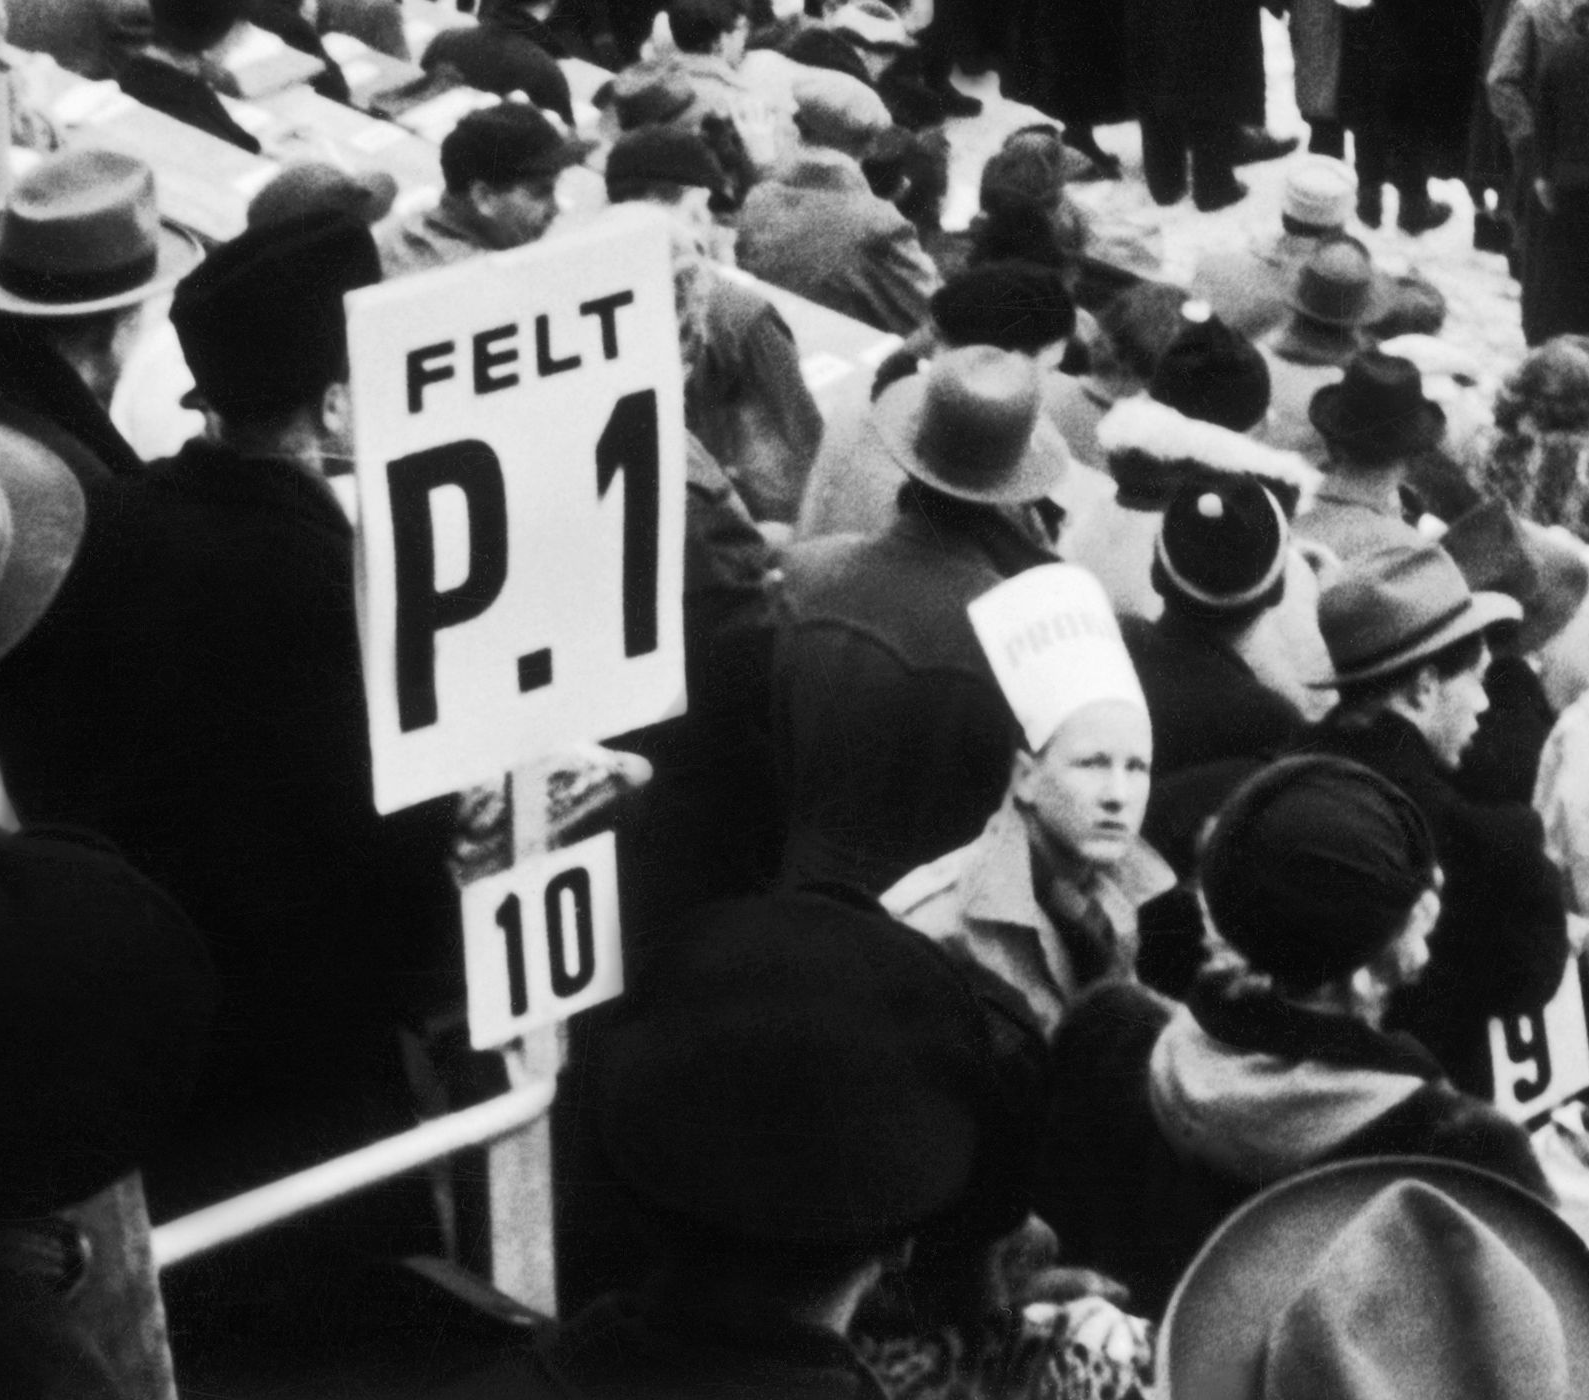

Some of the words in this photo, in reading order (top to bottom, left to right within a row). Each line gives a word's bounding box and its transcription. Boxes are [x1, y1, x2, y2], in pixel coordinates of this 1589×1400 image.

[406, 290, 634, 414] FELT
[386, 388, 660, 734] P.1
[495, 866, 596, 1018] 10
